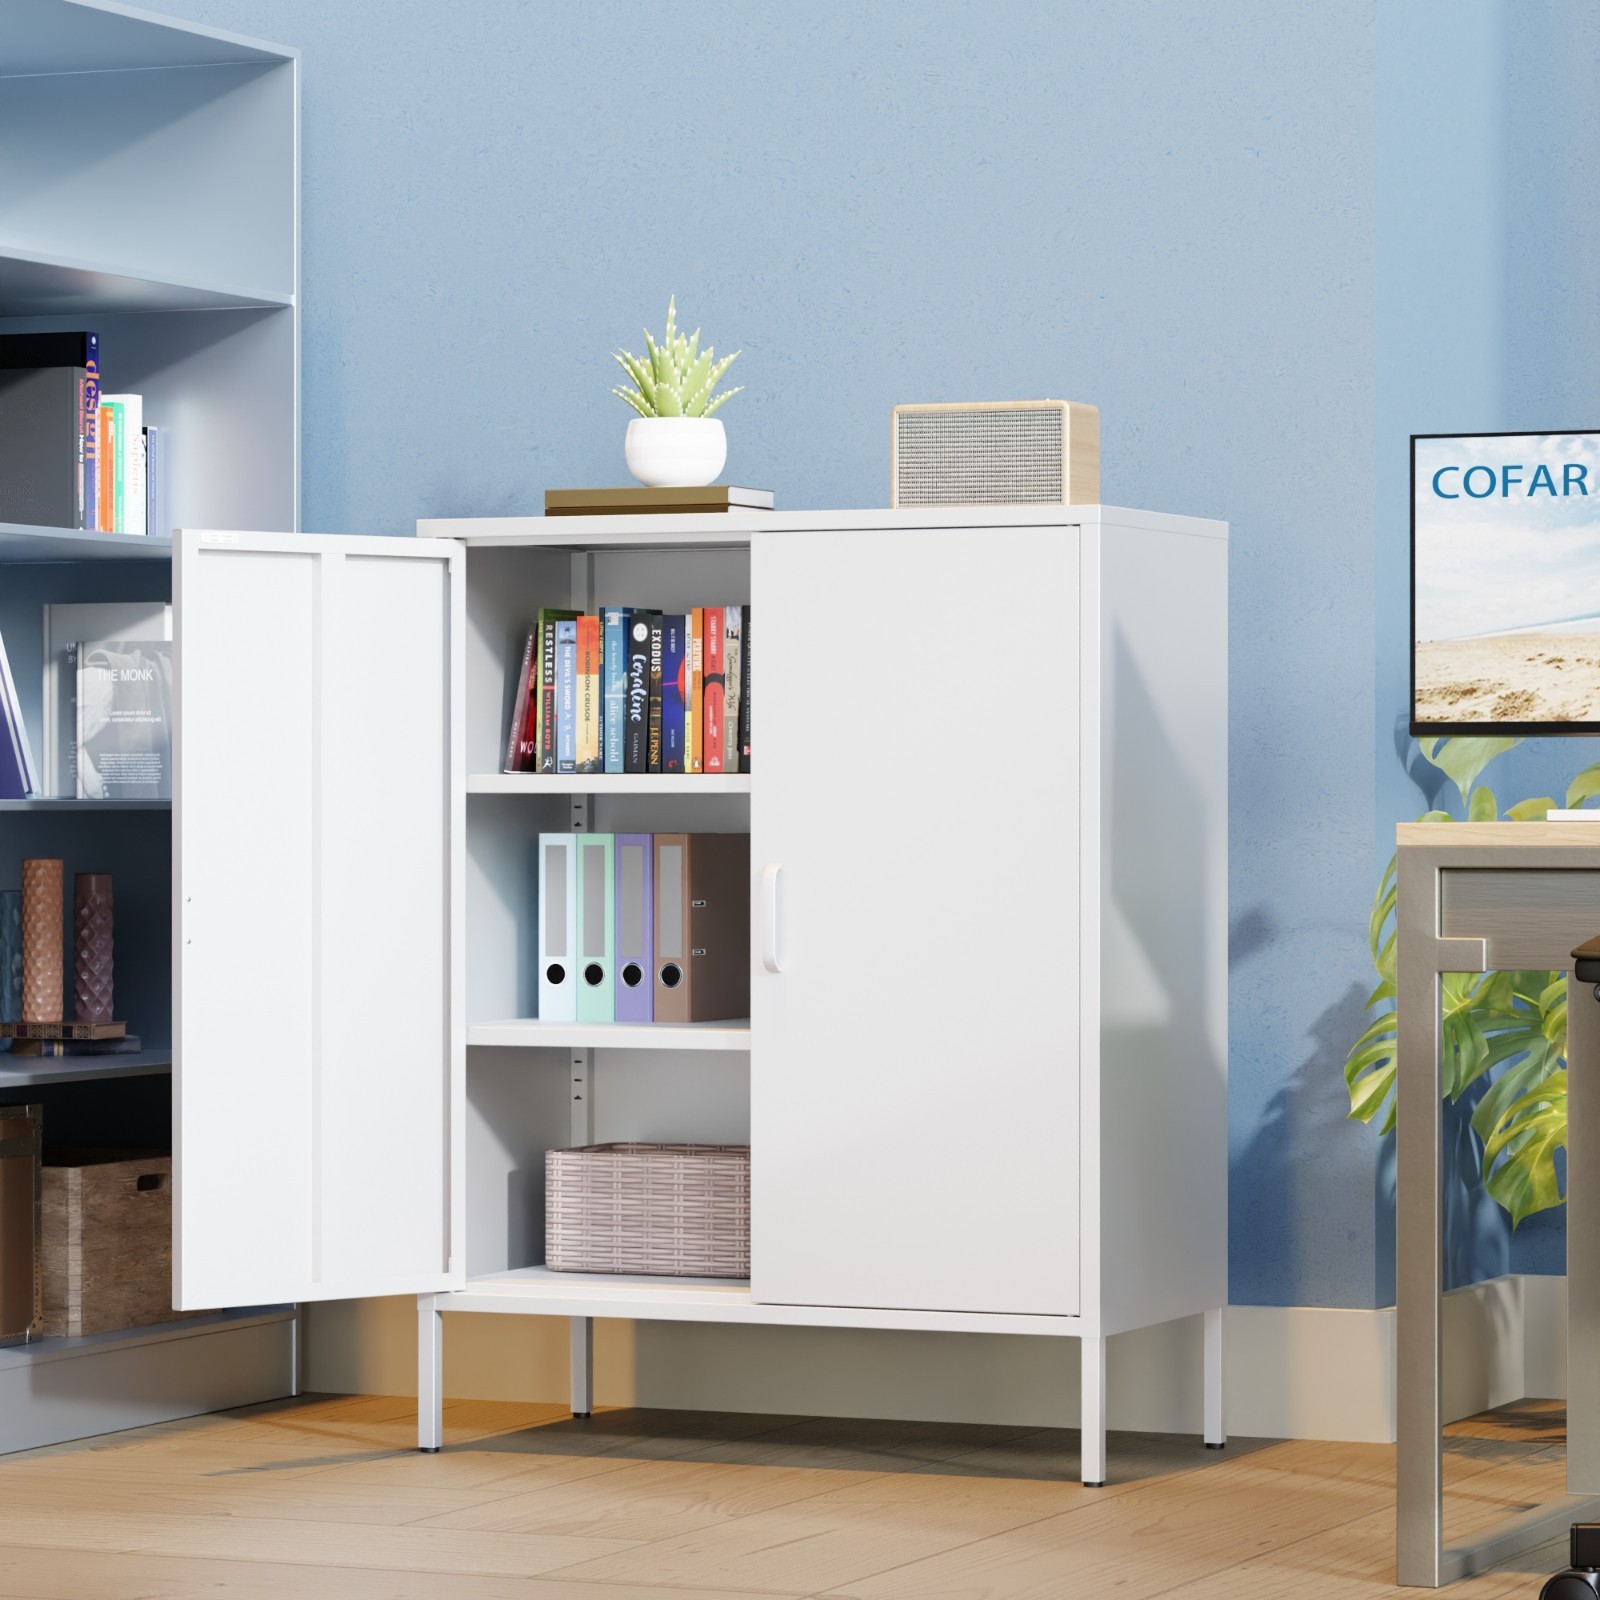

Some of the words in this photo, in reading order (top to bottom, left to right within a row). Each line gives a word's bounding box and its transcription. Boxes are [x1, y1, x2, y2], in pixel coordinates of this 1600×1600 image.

[86, 359, 100, 461] design
[1432, 463, 1589, 499] COFAR
[544, 624, 553, 684] RESTLESS
[609, 652, 618, 671] lovely
[651, 629, 662, 672] EXODUS
[692, 638, 702, 671] PERFUME
[97, 668, 119, 682] THE
[120, 668, 154, 681] MONK
[630, 654, 647, 723] Coraline
[123, 710, 135, 718] ipsum
[609, 700, 619, 725] alice
[725, 693, 737, 711] Wife
[609, 727, 619, 762] sebold
[650, 739, 659, 765] PENN
